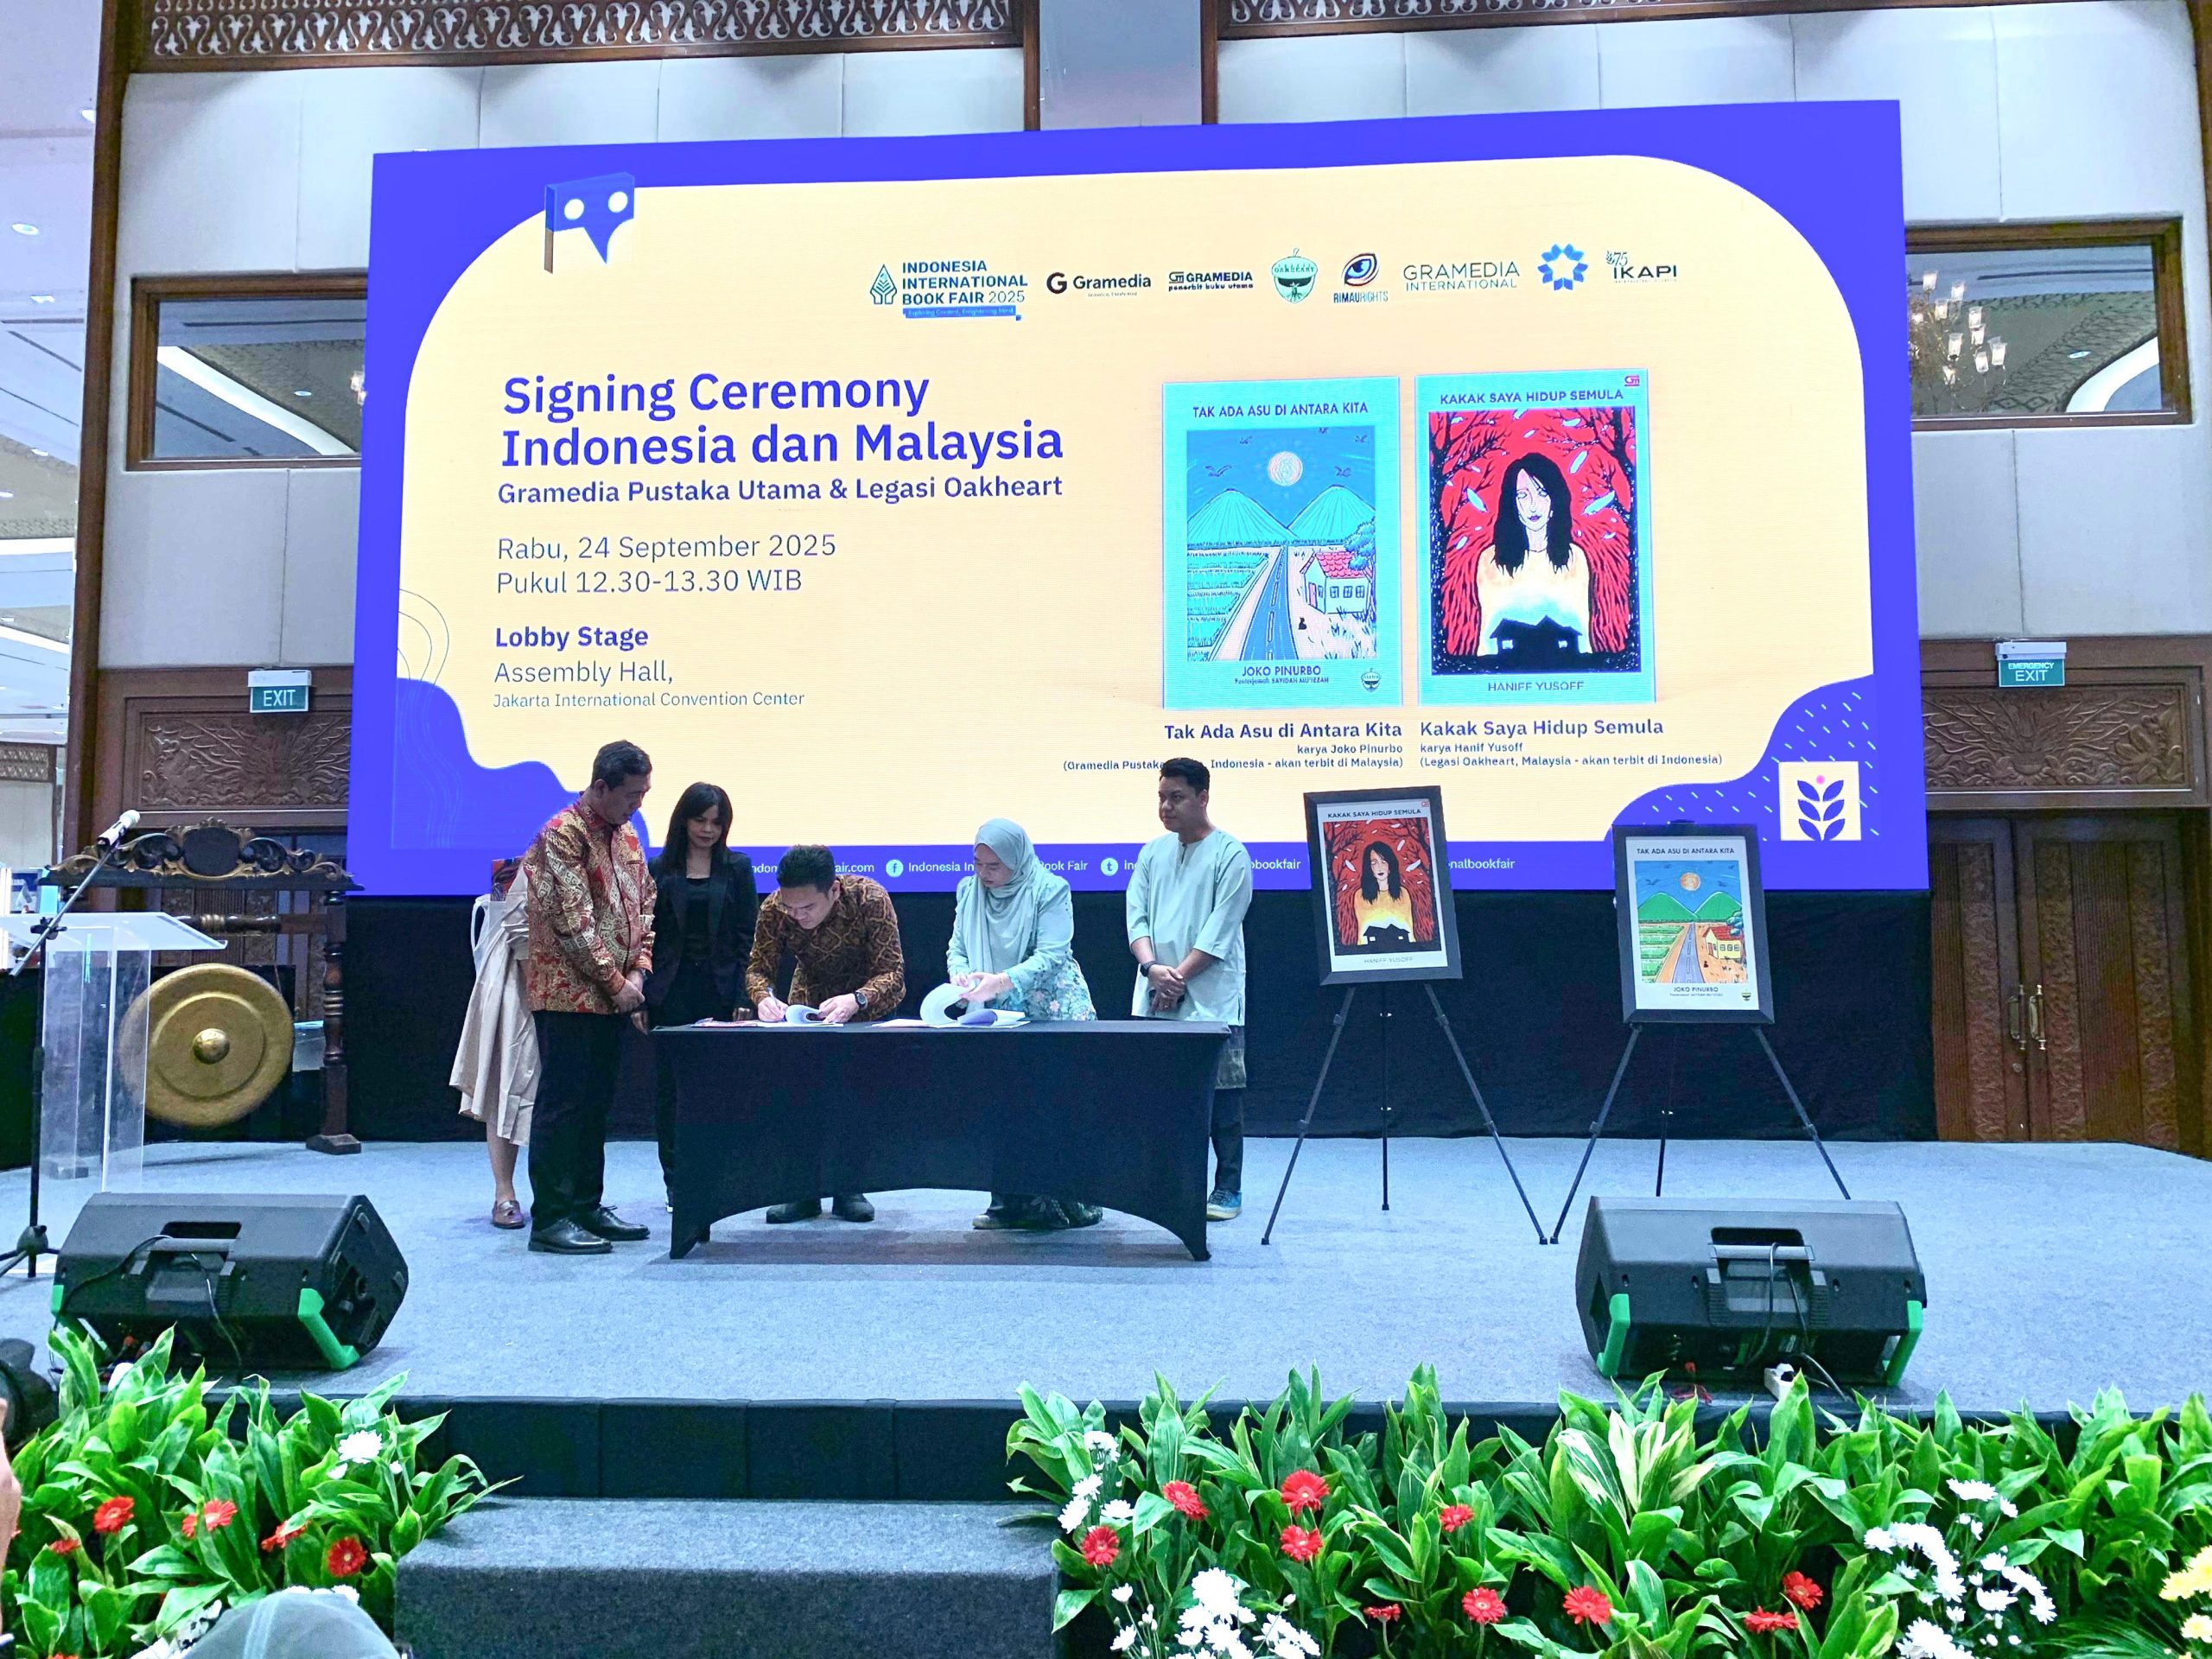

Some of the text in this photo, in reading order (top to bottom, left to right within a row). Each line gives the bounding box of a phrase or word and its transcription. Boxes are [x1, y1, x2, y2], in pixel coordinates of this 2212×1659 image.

[902, 260, 988, 274] INDONESIA
[1403, 261, 1521, 280] GRAMEDIA
[1613, 265, 1677, 279] IKAPI
[902, 274, 1028, 289] INTERNATIONAL
[1072, 273, 1152, 289] Gramedia
[1186, 270, 1253, 283] GRAMEDIA
[1406, 278, 1517, 292] INTERNATIONAL
[902, 289, 1026, 306] BOOK FAIR 2025
[1333, 291, 1389, 303] RIMAURIGHTS
[503, 372, 930, 423] Signing Ceremony
[1440, 389, 1624, 404] KAKAK SAYA HIDUP SEMULA
[1193, 402, 1369, 418] TAK ADA ASU DI ANTARA KITA
[501, 420, 1064, 469] Indonesia dan Malaysia
[498, 474, 1063, 505] Gramedia Pustaka Utama & Legasi Oakheart
[497, 533, 836, 563] Rabu, 24 September 2025
[497, 569, 803, 594] Pukul 12.30-13.30 WIB
[495, 625, 650, 652] Lobby Stage
[493, 658, 675, 686] Assembly Hall,
[1242, 664, 1321, 677] JOKO PINURBO
[2015, 670, 2048, 682] EXIT
[1487, 681, 1584, 692] HANIFF YUSOFF
[263, 689, 296, 707] EXIT
[493, 689, 805, 709] Jakarta International Convention Center
[1164, 721, 1402, 740] Tak Ada Asu di Antara Kita
[1421, 719, 1664, 739] Kakak Saya Hidup Semula
[1297, 742, 1403, 756] karya Joko Pinurbo
[1421, 741, 1523, 754] karya Hanif Yusoff
[1063, 760, 1120, 772] (Gramedia
[1211, 758, 1264, 769] Indonesia
[1274, 758, 1301, 769] akan
[1304, 757, 1334, 768] terbit
[1337, 757, 1349, 767] di
[1351, 756, 1404, 770] Malaysia)
[1420, 756, 1460, 768] (Legasi
[1463, 755, 1518, 768] Oakheart,
[1522, 755, 1572, 767] Malaysia
[1582, 755, 1610, 766] akan
[1612, 754, 1643, 766] terbit
[1647, 754, 1658, 765] di
[1662, 753, 1723, 766] Indonesia)
[908, 861, 961, 873] Indonesia
[1067, 860, 1089, 871] Fair
